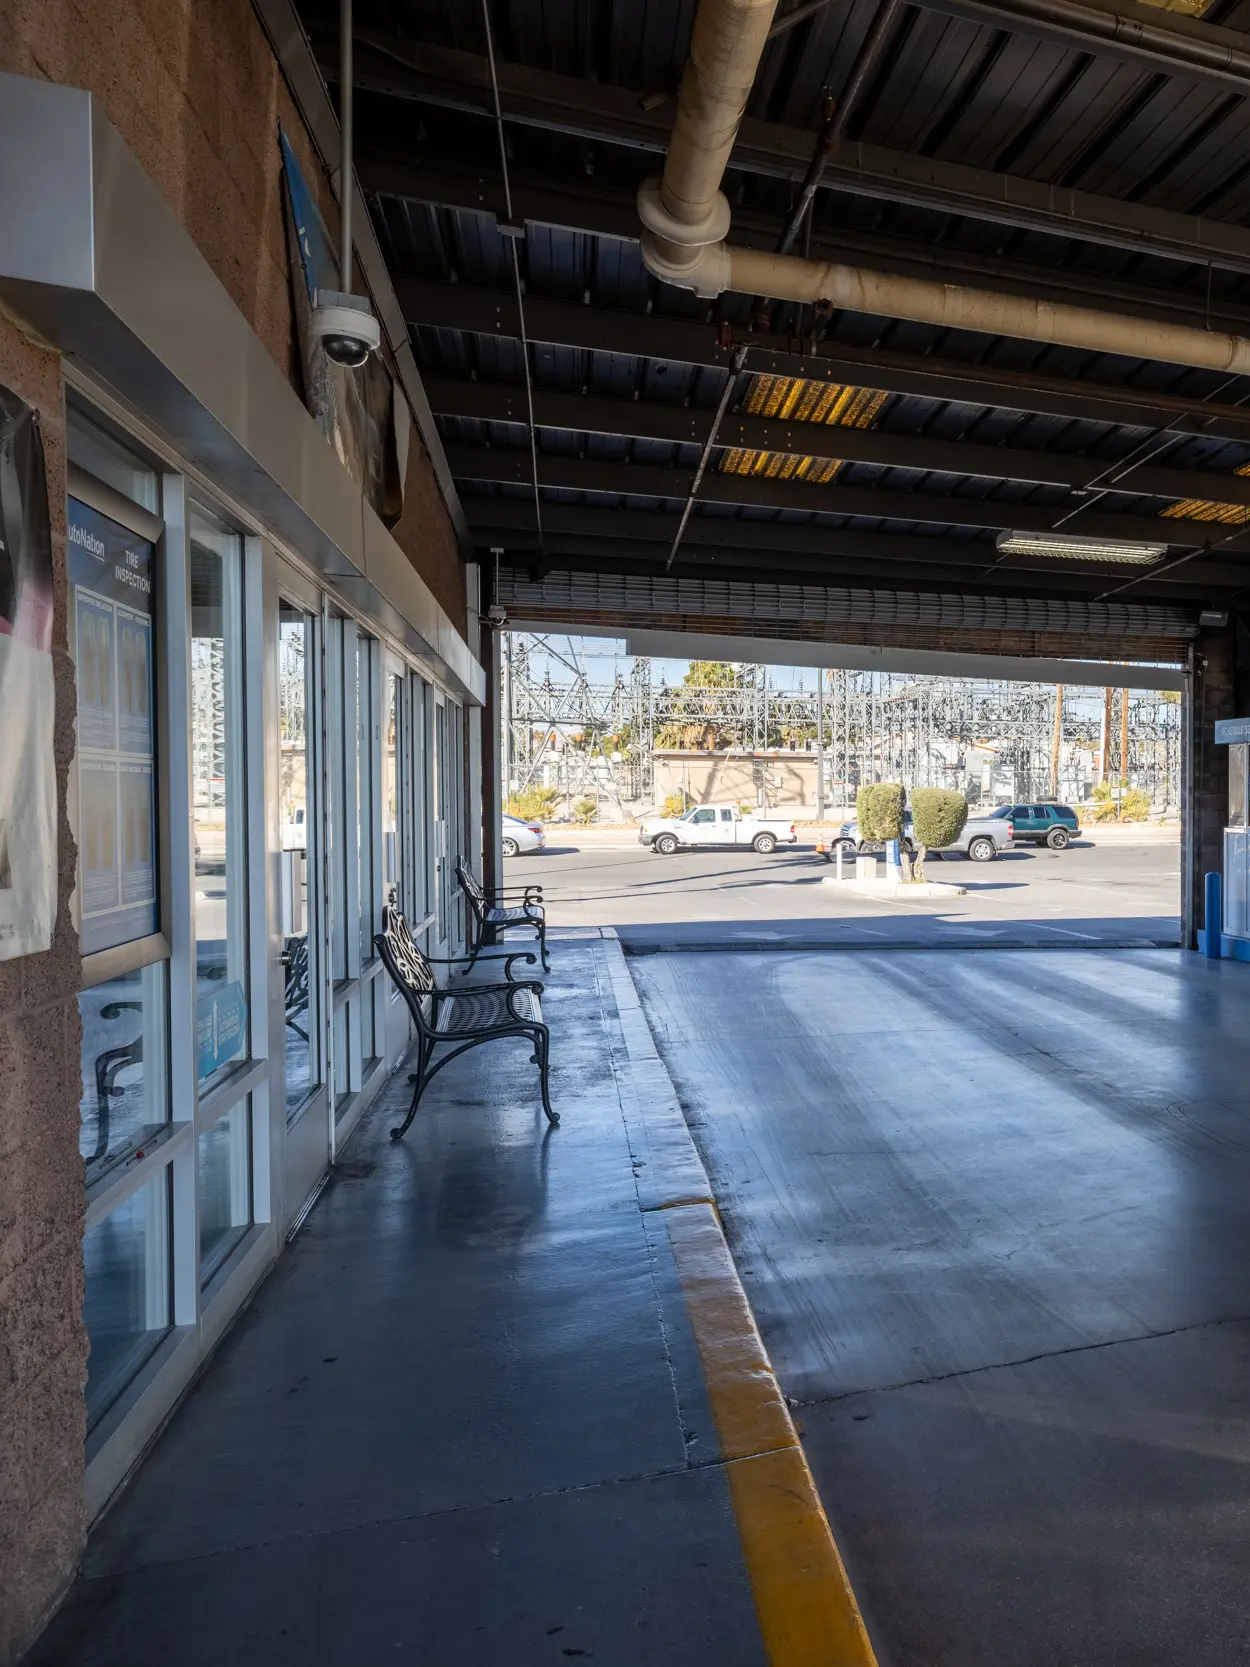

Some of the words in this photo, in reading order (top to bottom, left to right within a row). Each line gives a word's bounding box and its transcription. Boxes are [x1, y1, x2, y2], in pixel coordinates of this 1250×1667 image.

[68, 525, 105, 557] utoNation
[125, 550, 139, 568] TIRE
[115, 567, 151, 593] INSPECTION
[1221, 725, 1244, 736] SCHEDULE
